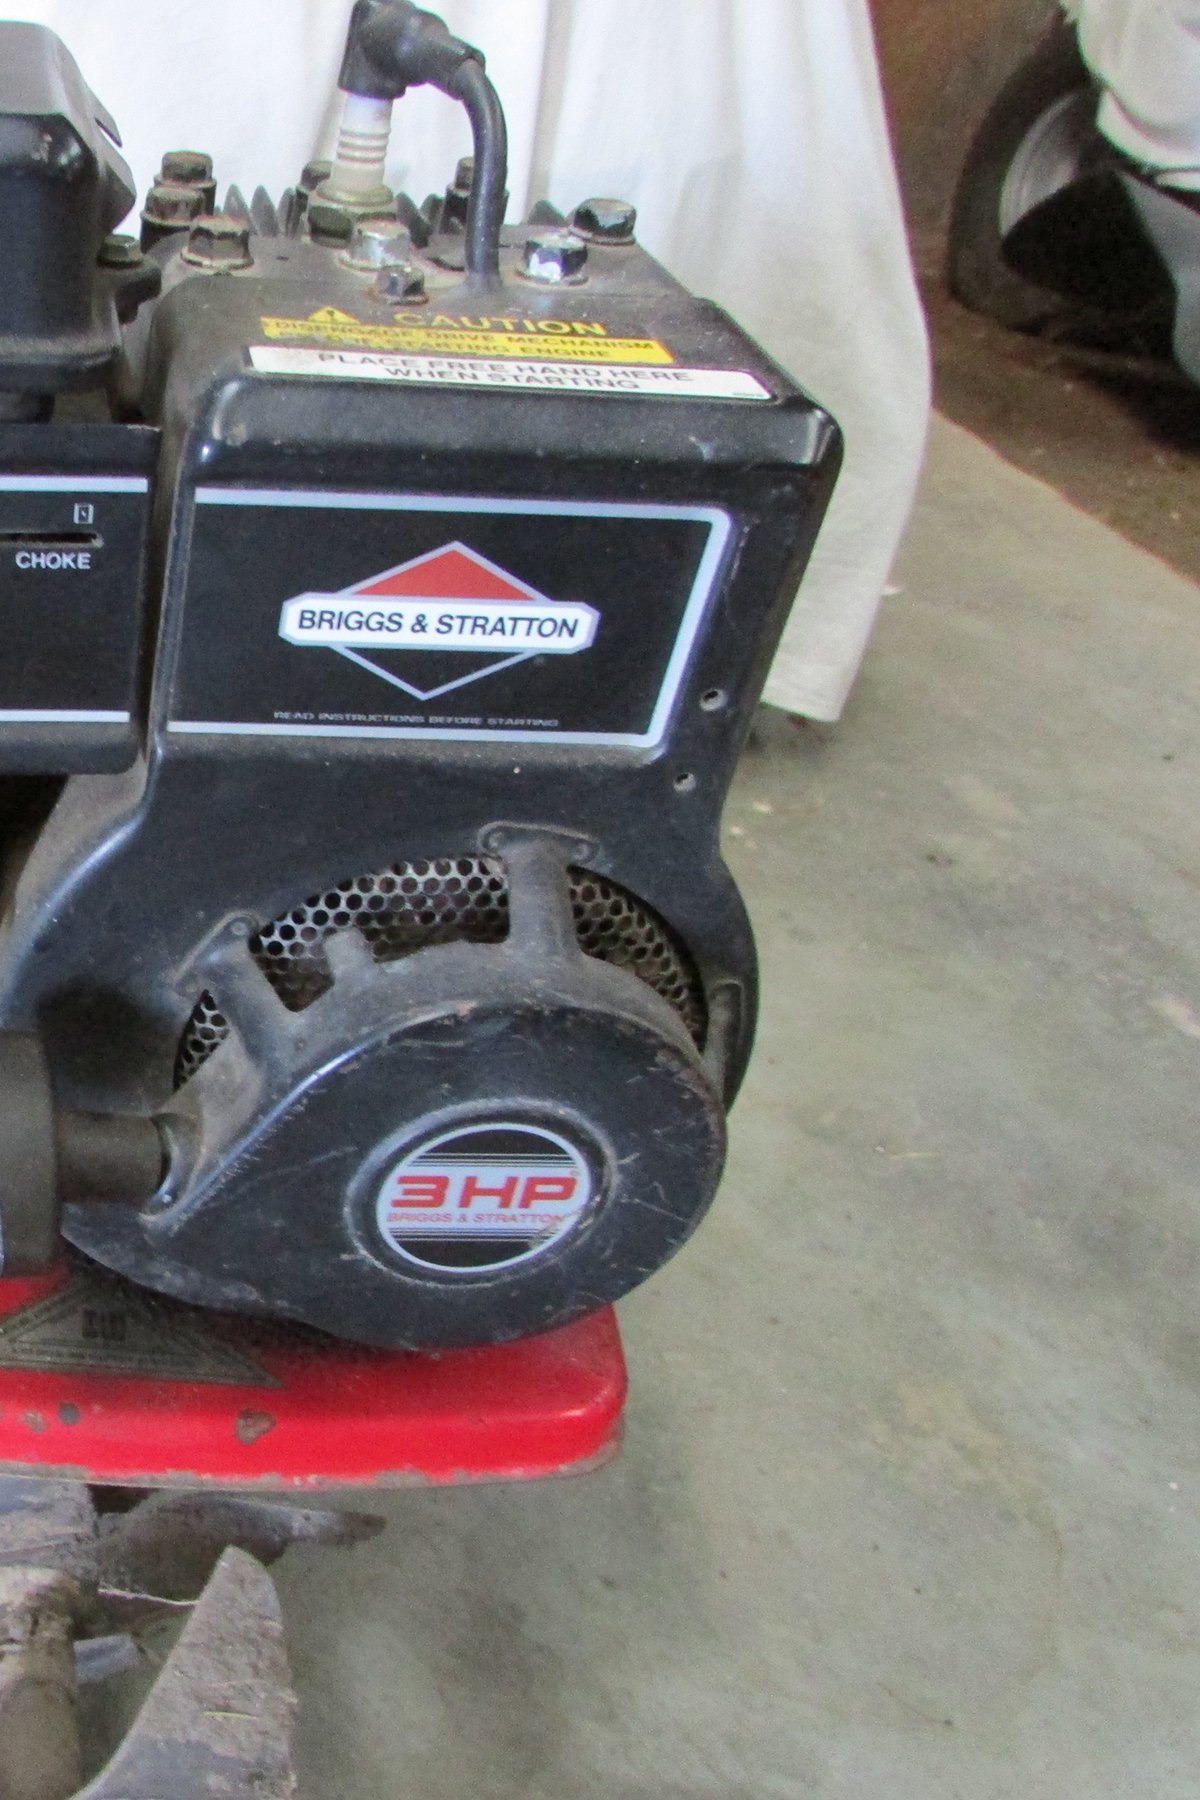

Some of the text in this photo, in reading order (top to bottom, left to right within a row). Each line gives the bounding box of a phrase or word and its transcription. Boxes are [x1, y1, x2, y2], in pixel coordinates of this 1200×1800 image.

[394, 313, 607, 336] CAUTION
[425, 330, 494, 342] DRIVE
[507, 336, 654, 349] MECHANISM
[520, 347, 610, 358] ENGINE
[318, 352, 693, 382] PLACE FREE HAND HERE
[385, 368, 640, 389] WHEN STARTING
[15, 551, 92, 570] CHOKE
[298, 609, 579, 638] BRIGGS & STRATTON
[273, 711, 559, 727] READ INSTRUCTIONS BEFORE STARTING
[387, 1213, 566, 1224] BRIGGS & STRATTON
